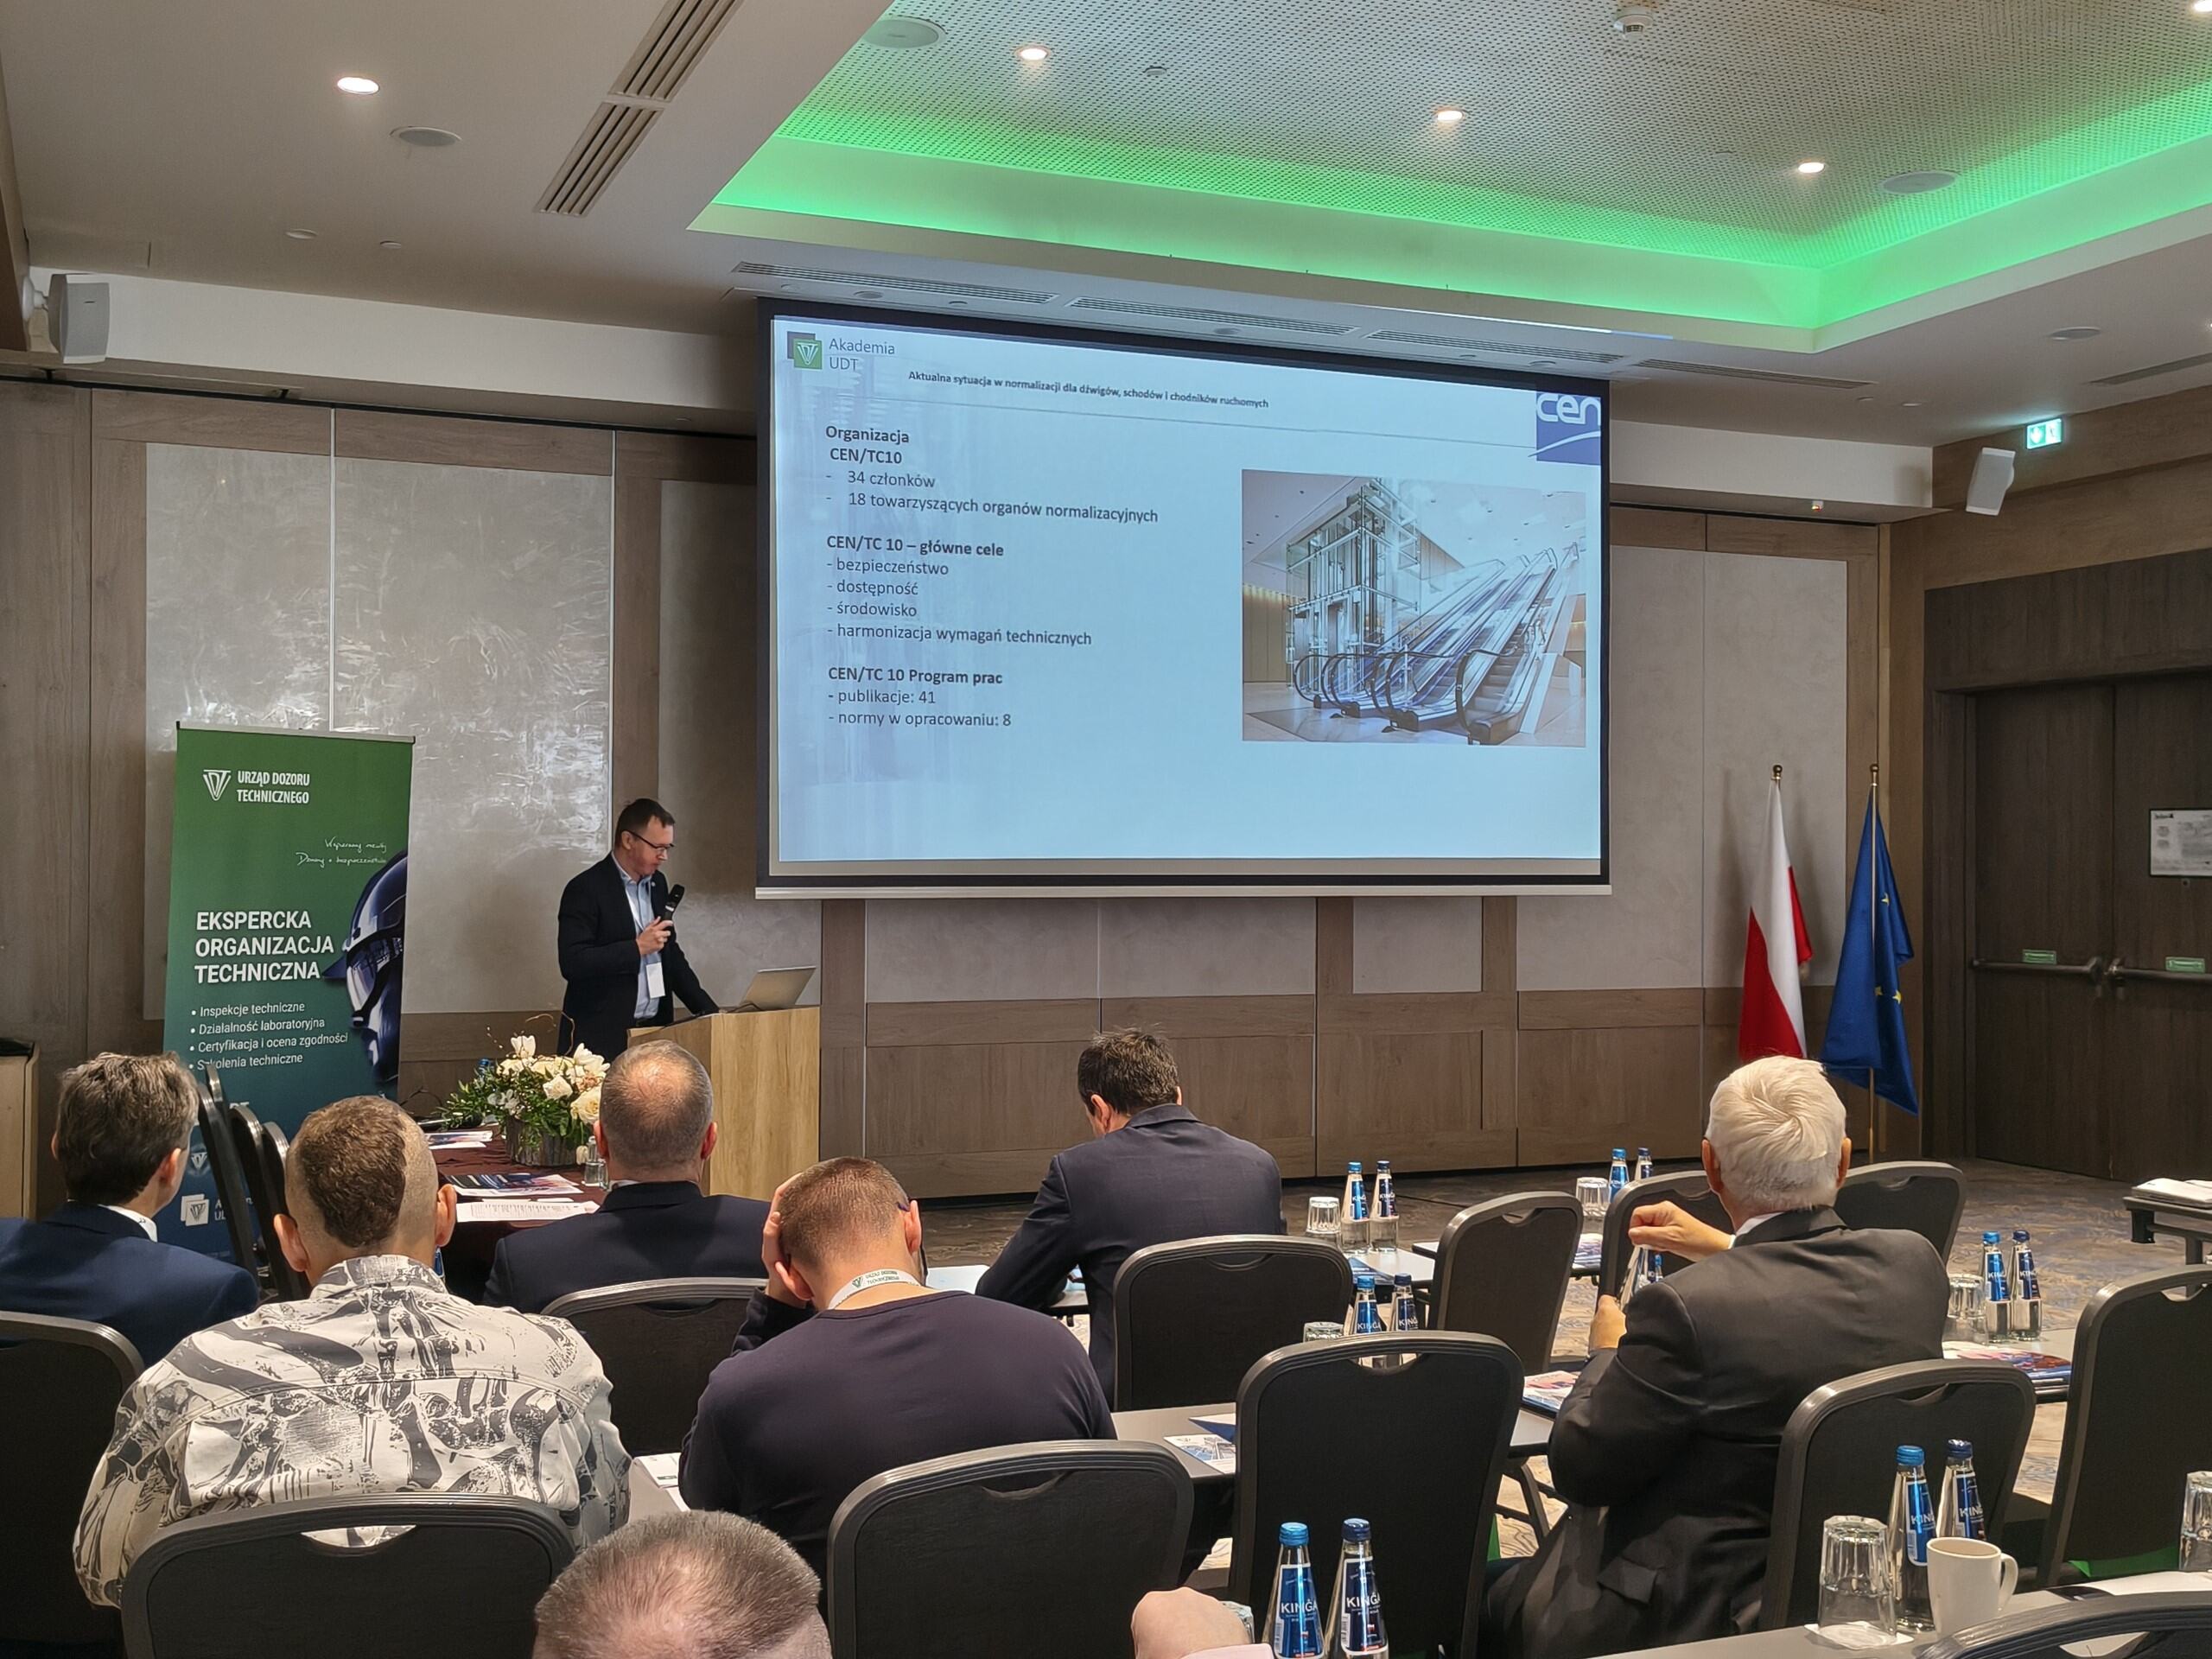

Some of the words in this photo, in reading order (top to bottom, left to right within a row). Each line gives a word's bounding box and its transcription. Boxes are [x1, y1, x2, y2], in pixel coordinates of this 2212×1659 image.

[829, 338, 895, 355] Akademia
[830, 357, 859, 372] UDT
[908, 371, 951, 383] Aktualna
[953, 374, 992, 387] sytuacja
[1005, 380, 1061, 393] normalizacji
[1063, 383, 1077, 393] dla
[1122, 389, 1162, 400] schodów
[1170, 392, 1218, 404] chodników
[1220, 397, 1269, 409] ruchomych
[825, 425, 910, 445] Organizacja
[830, 448, 902, 464] CEN/TC10
[848, 471, 865, 484] 34
[869, 472, 936, 488] członków
[849, 493, 866, 505] 18
[870, 493, 978, 512] towarzyszących
[982, 500, 1042, 517] organów
[1046, 504, 1159, 524] normalizacyjnych
[826, 535, 882, 552] CEN/TC
[886, 537, 903, 552] 10
[919, 539, 972, 556] główne
[976, 541, 1004, 556] cele
[836, 558, 949, 576] bezpieczeństwo
[836, 580, 918, 597] dostępność
[836, 601, 917, 618] środowisko
[836, 625, 932, 642] harmonizacja
[936, 627, 1002, 645] wymagań
[1006, 629, 1092, 646] technicznych
[828, 665, 883, 683] CEN/TC
[887, 668, 905, 682] 10
[909, 669, 969, 686] Program
[973, 672, 1003, 687] prac
[837, 690, 914, 705] publikacje:
[918, 691, 936, 704] 41
[838, 713, 885, 727] normy
[888, 715, 900, 725] w
[905, 712, 999, 728] opracowaniu:
[1002, 713, 1011, 727] 8
[238, 770, 270, 787] URZĄD
[272, 772, 310, 786] DOZORU
[236, 788, 309, 804] TECHNICZNEGO
[196, 911, 312, 931] EKSPERCKA
[194, 935, 334, 957] ORGANIZACJA
[194, 961, 321, 984] TECHNICZNA
[200, 1004, 249, 1018] Inspekcje
[251, 1001, 305, 1014] techniczne
[199, 1020, 258, 1035] Działalność
[261, 1018, 325, 1031] laboratoryjna
[198, 1039, 258, 1053] Certyfikacja
[266, 1037, 296, 1048] ocena
[299, 1033, 348, 1048] zgodności
[197, 1057, 246, 1071] Solenia
[249, 1053, 302, 1066] techniczne
